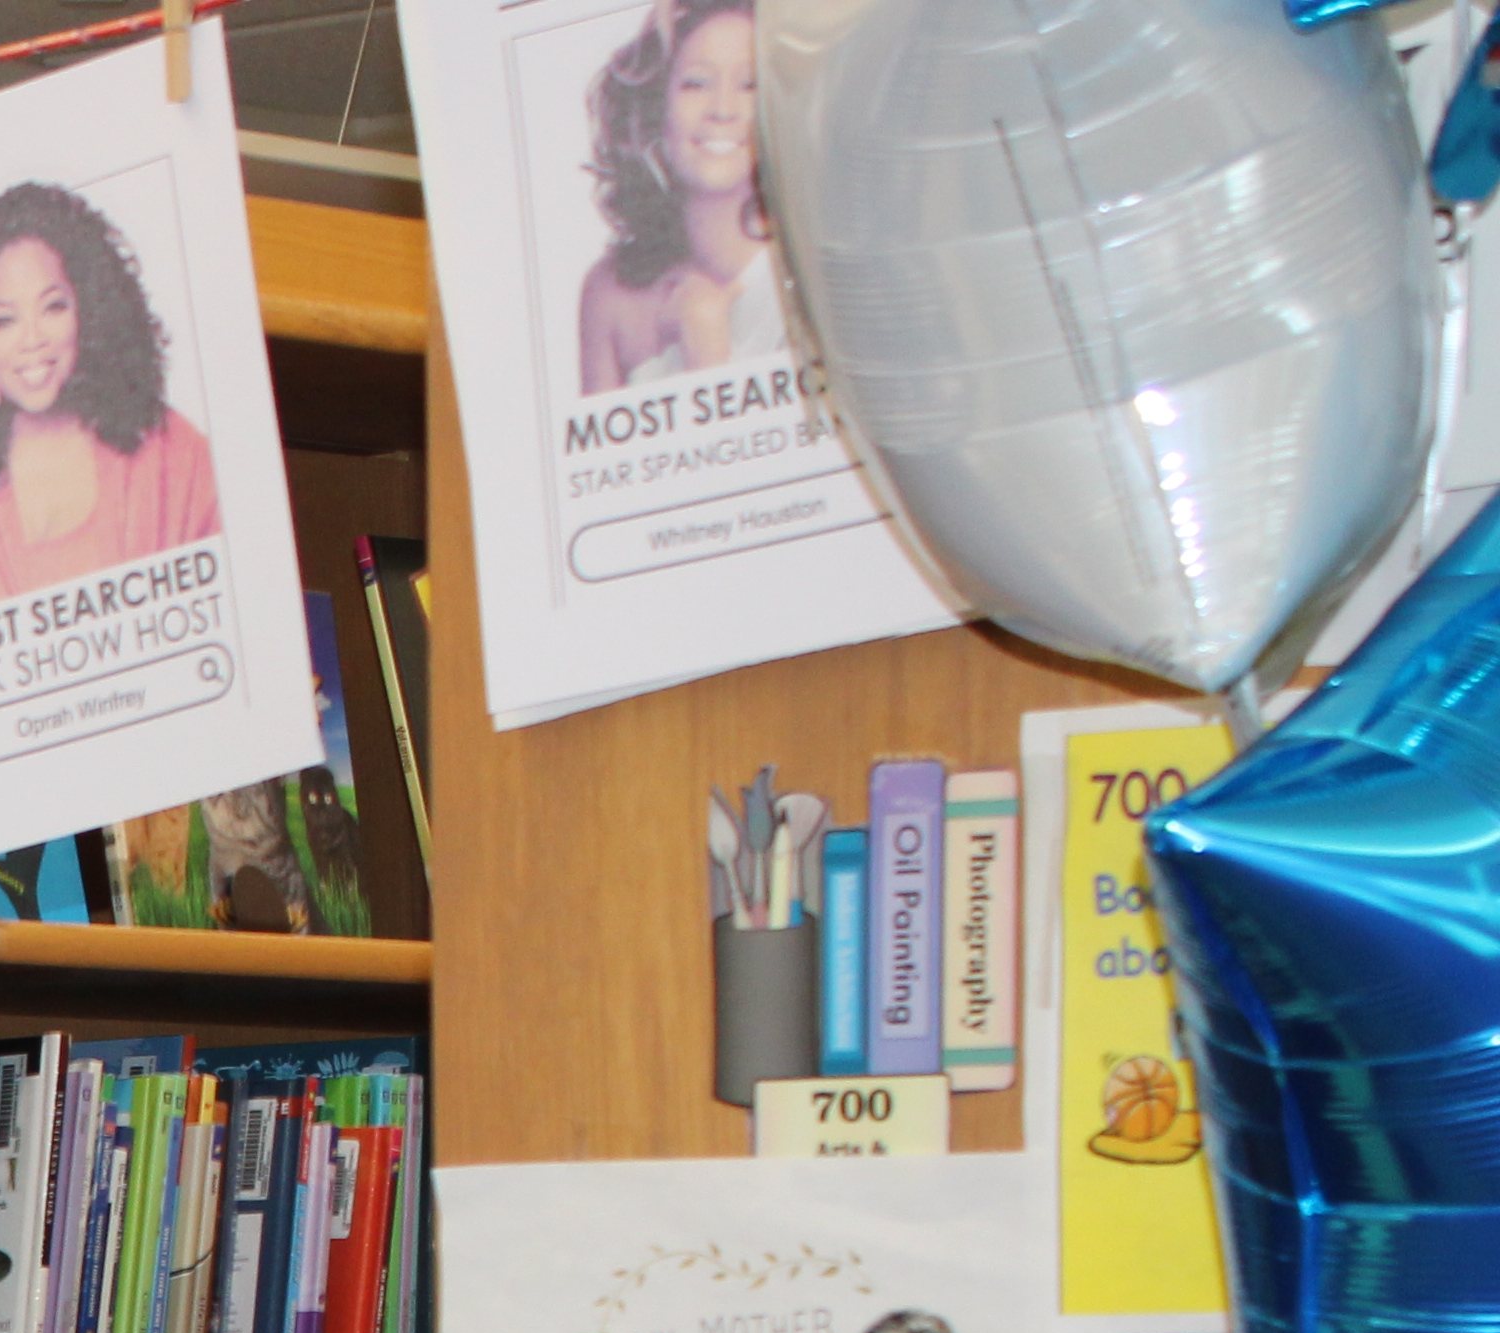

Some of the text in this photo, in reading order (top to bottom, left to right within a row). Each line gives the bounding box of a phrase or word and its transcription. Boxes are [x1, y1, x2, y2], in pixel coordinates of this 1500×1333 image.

[566, 395, 680, 455] MOST
[569, 428, 788, 499] STAR SPANGLED
[648, 499, 827, 551] Whitney Houston
[31, 549, 218, 636] SEARCHED
[15, 625, 124, 687] SHOW
[135, 595, 224, 650] HOST
[17, 685, 147, 740] Oprah Winfrey
[884, 824, 924, 1026] Oil Painting
[961, 829, 998, 1037] Photography
[811, 1090, 893, 1123] 700
